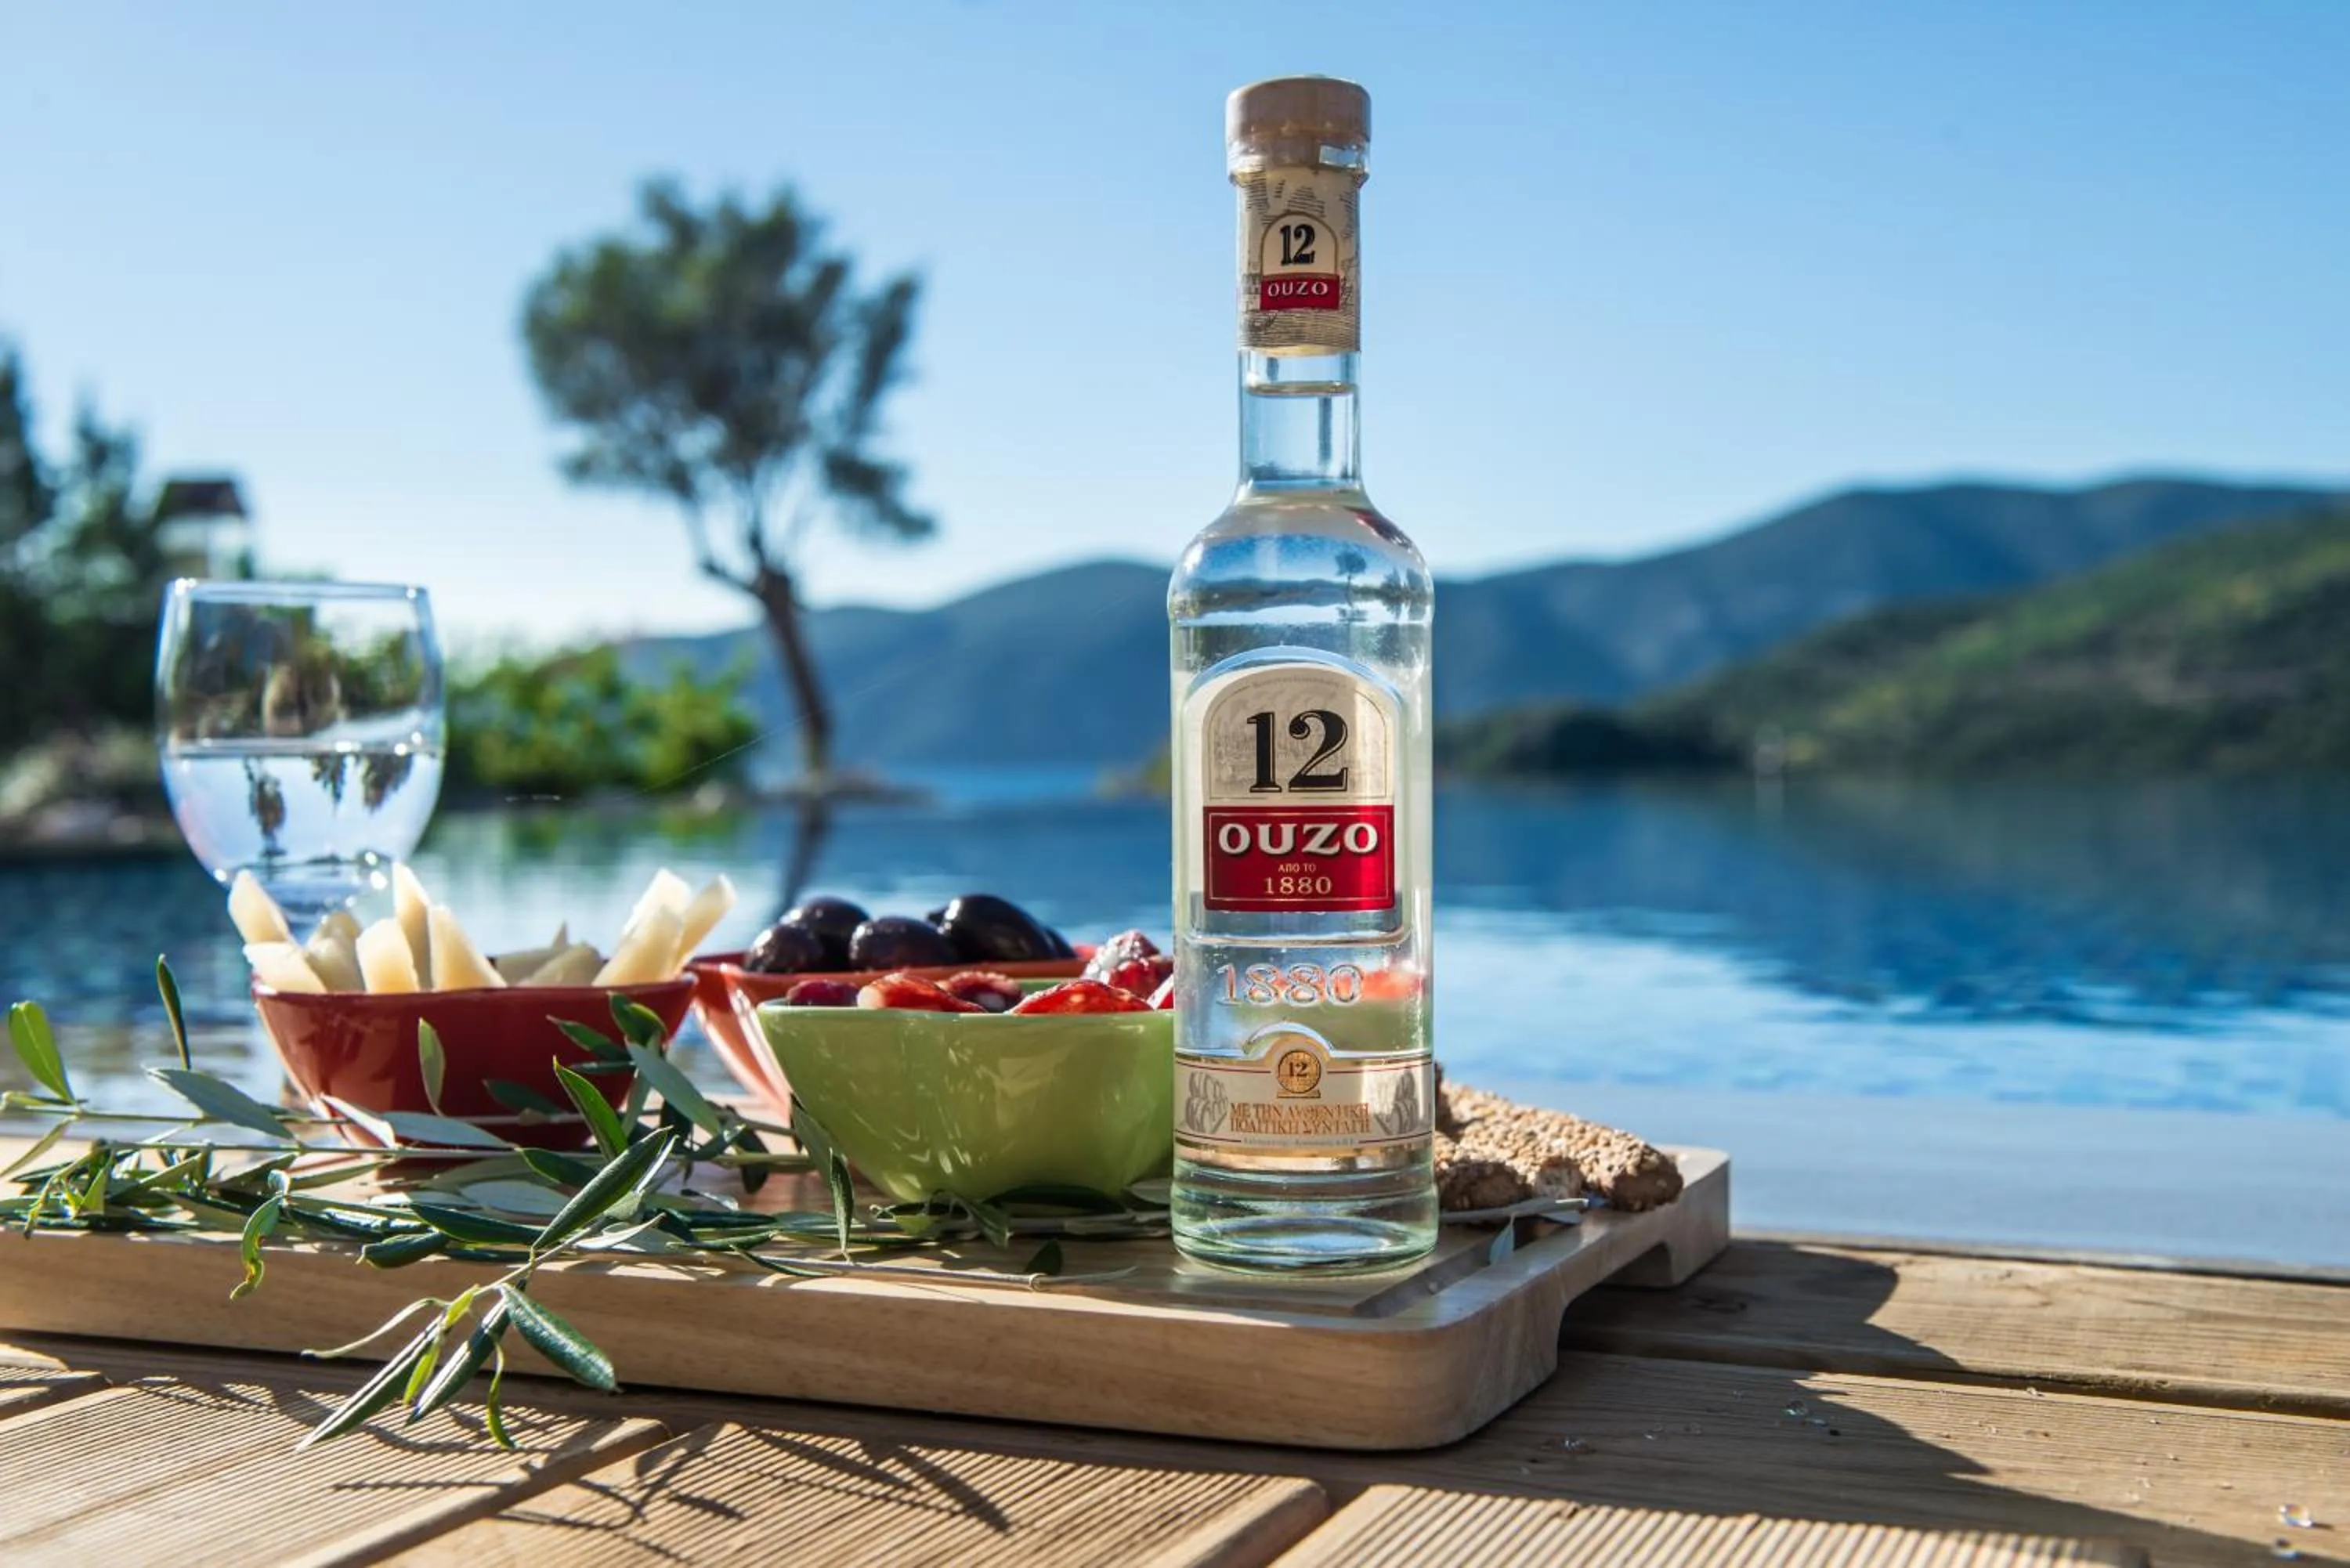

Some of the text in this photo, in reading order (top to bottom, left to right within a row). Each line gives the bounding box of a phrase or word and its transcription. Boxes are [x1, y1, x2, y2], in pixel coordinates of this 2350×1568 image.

[1280, 223, 1315, 266] 12
[1267, 281, 1329, 297] OUZO
[1247, 710, 1348, 793] 12
[1218, 822, 1378, 854] OUZO
[1278, 862, 1300, 873] ΑΠΟ
[1264, 876, 1332, 894] 1880
[1216, 963, 1364, 1006] 1880
[1289, 1061, 1309, 1077] 12
